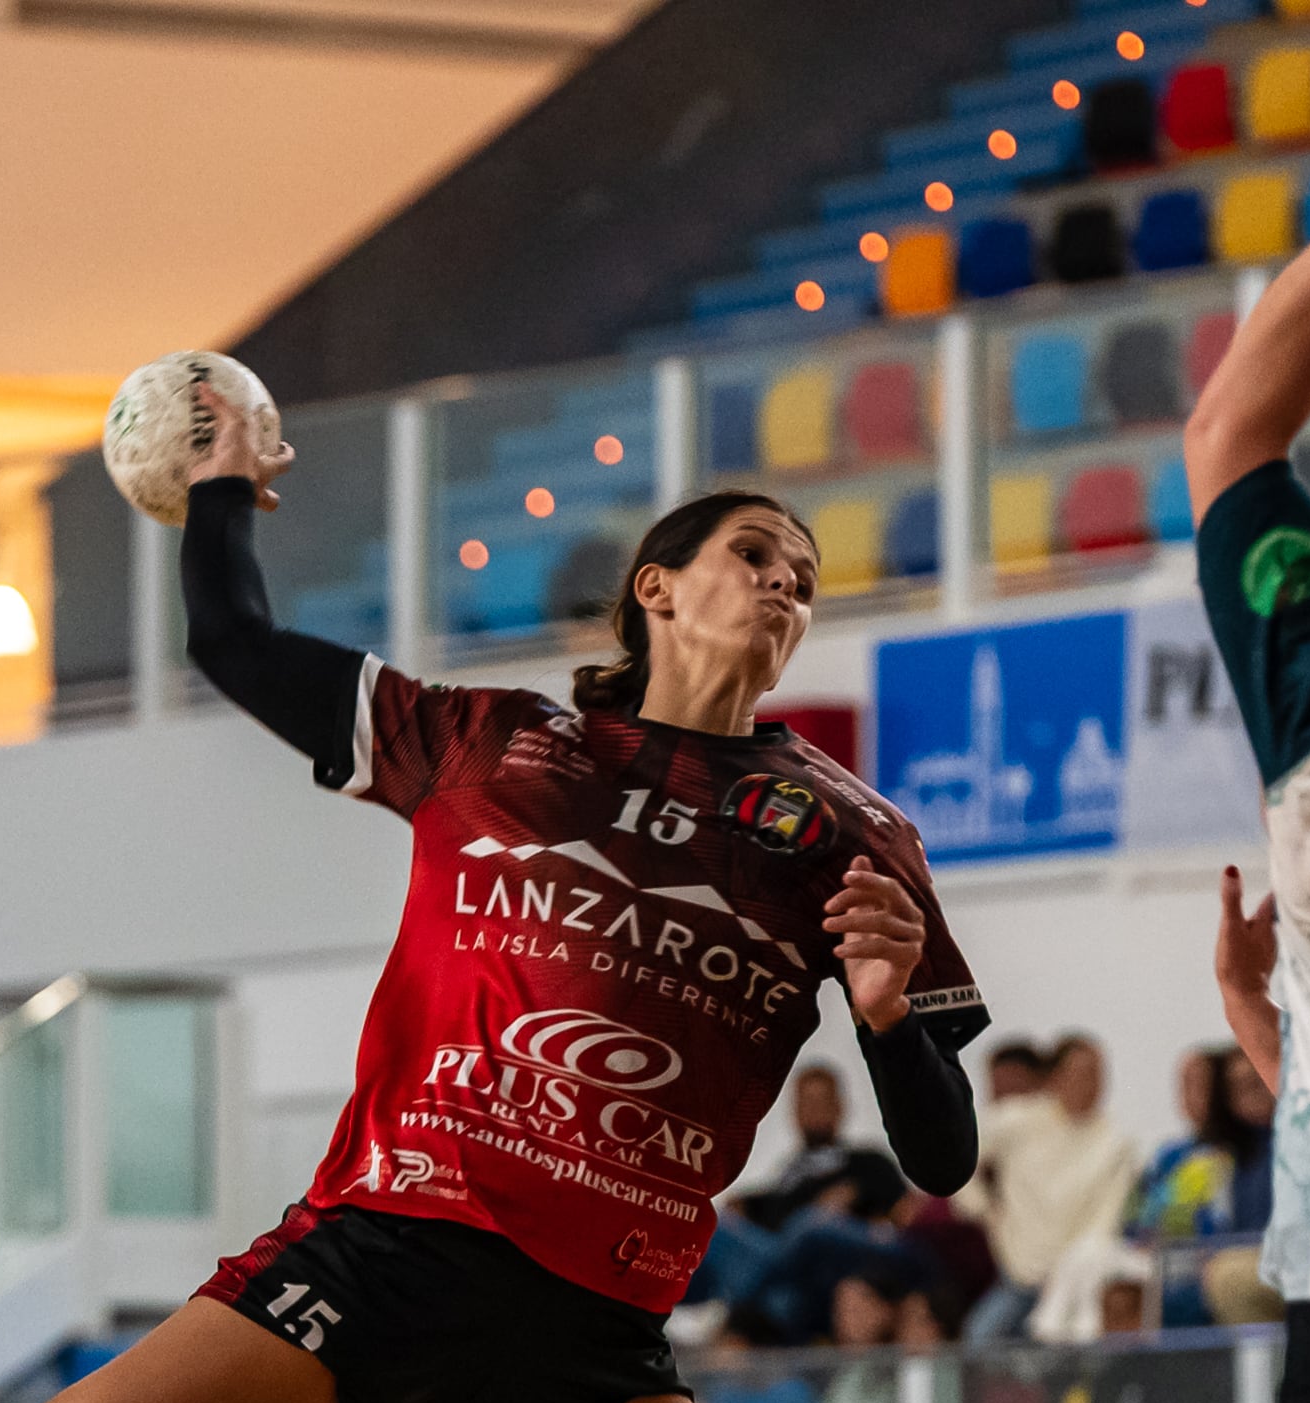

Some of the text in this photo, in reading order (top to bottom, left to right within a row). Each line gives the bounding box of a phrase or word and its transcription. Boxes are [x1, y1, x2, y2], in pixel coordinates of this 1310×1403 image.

[611, 788, 699, 846] 15
[453, 928, 770, 1046] LA ISLA DIFERENTE
[454, 872, 800, 1014] LANZAROTE
[951, 987, 975, 1003] SAN
[423, 1048, 714, 1175] PLUS CAR
[490, 1101, 644, 1168] RENT A CAR
[400, 1110, 700, 1223] www.autospluscar.com
[267, 1283, 342, 1352] 15
